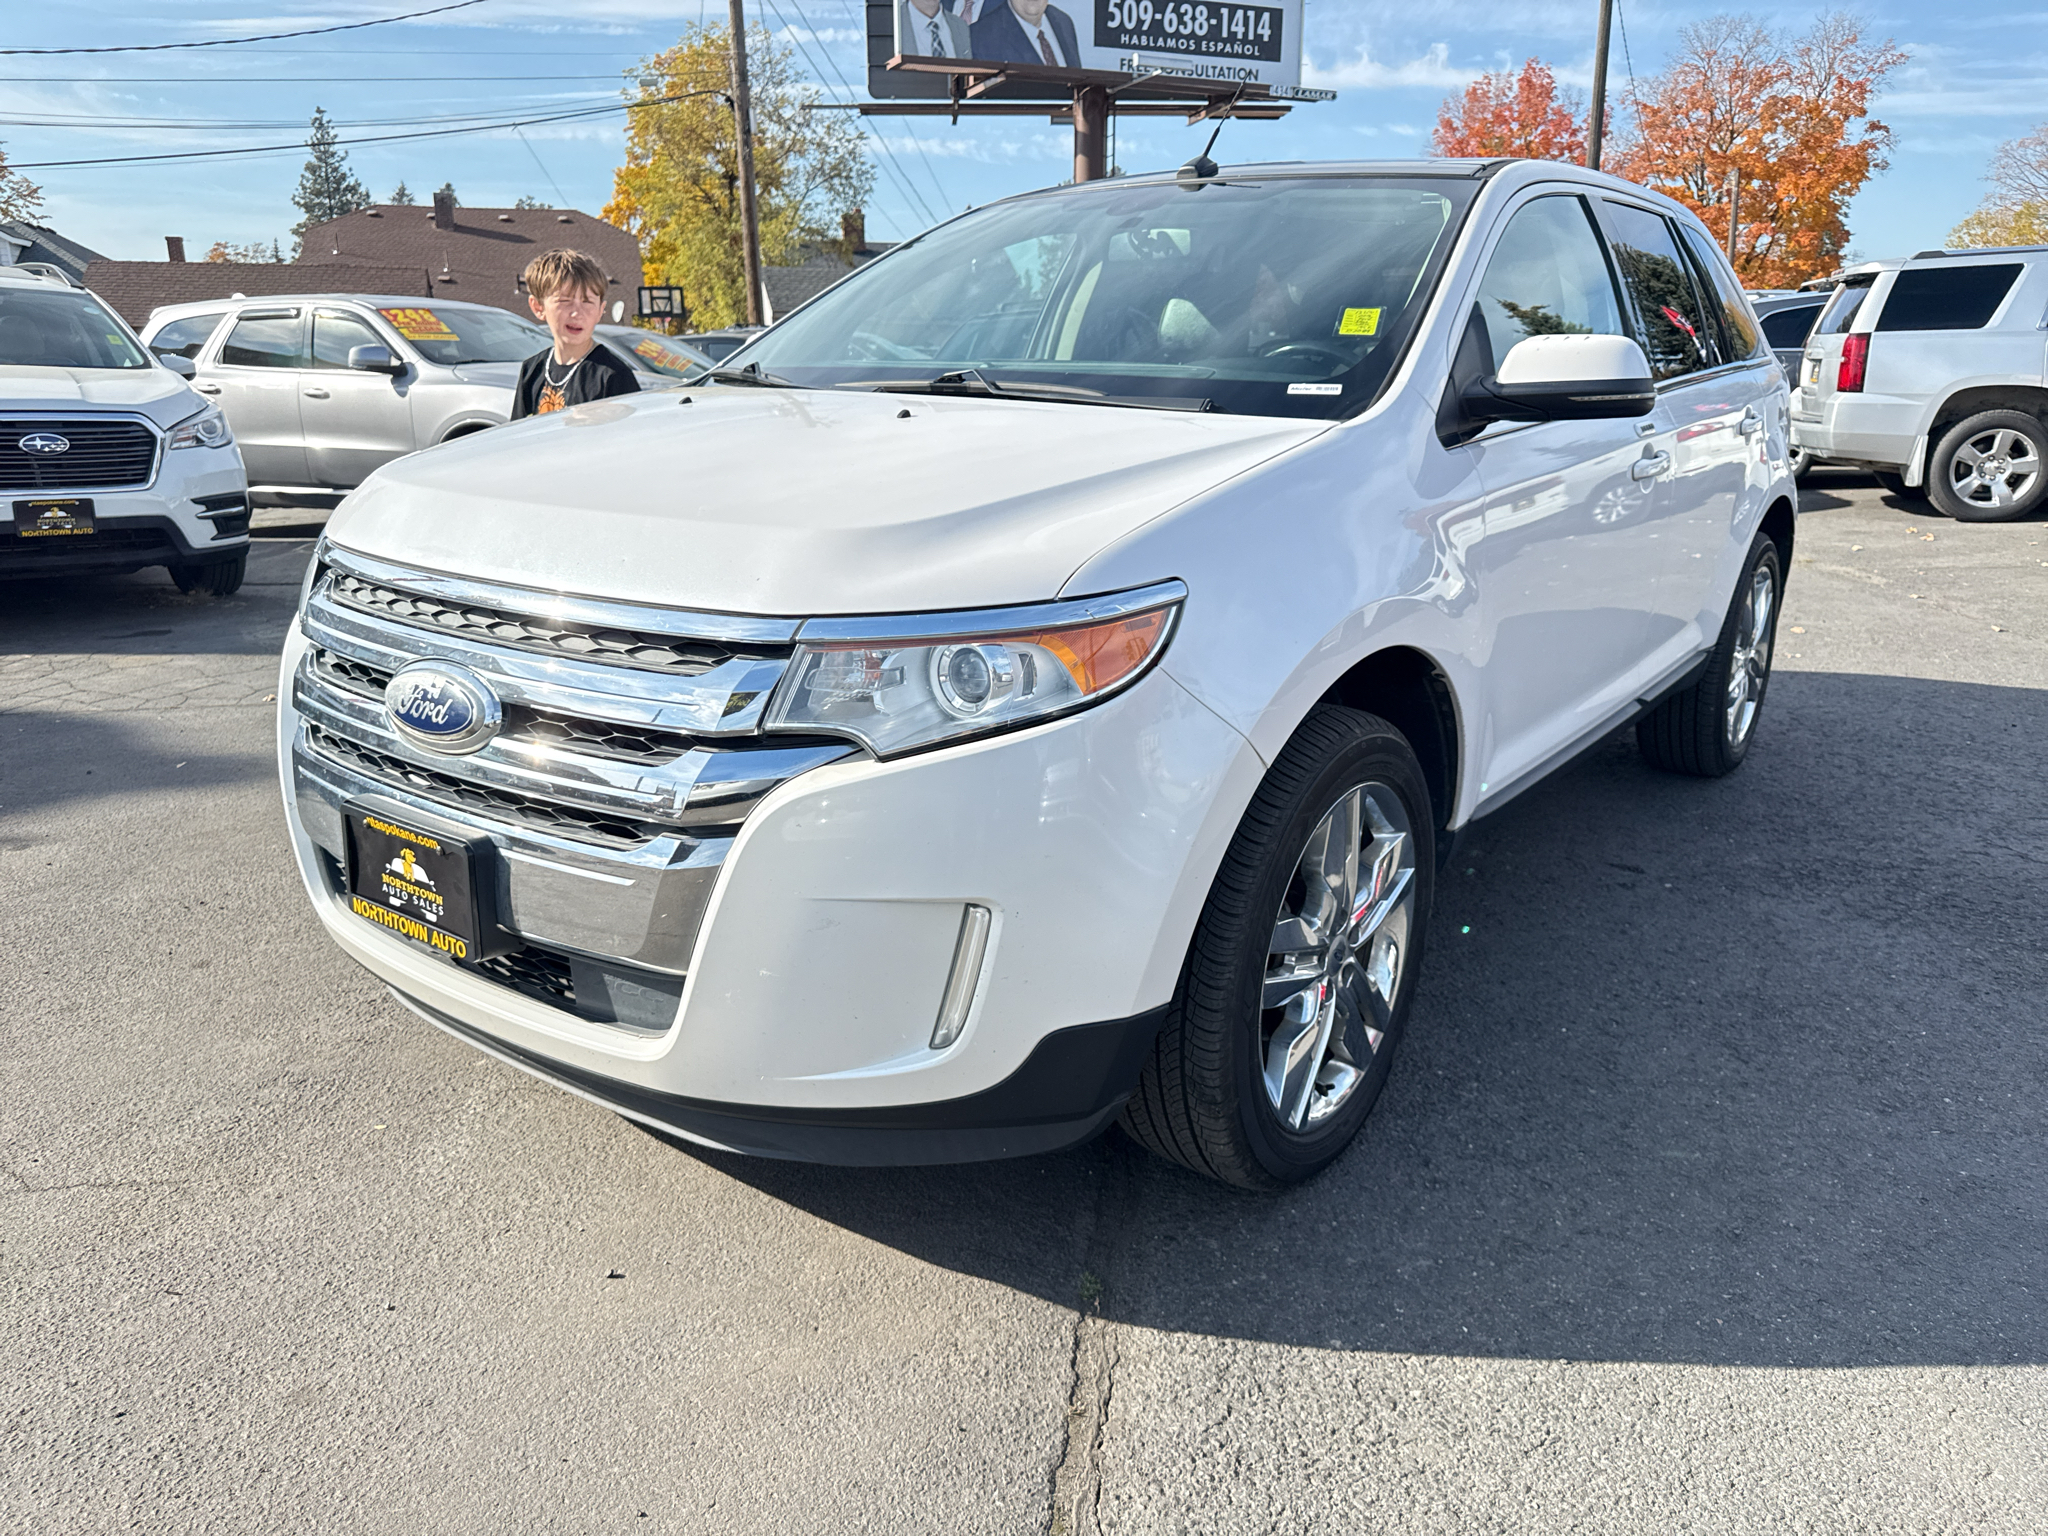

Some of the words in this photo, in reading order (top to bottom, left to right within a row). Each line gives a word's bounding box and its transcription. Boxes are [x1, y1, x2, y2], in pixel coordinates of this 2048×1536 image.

[1107, 0, 1272, 42] 509-638-1414
[1120, 33, 1196, 51] HABLAMOS
[1201, 40, 1261, 56] ESPAÑOL
[21, 528, 71, 537] NORTHTOWN
[73, 527, 94, 535] AUTO
[400, 684, 453, 725] Ford
[366, 816, 439, 850] ntaspokane.com
[381, 873, 444, 906] NORTHTOWN
[382, 883, 408, 900] AUTO
[412, 895, 444, 916] SALES
[353, 897, 429, 942] NORTHTOWN
[431, 930, 467, 959] AUTO
